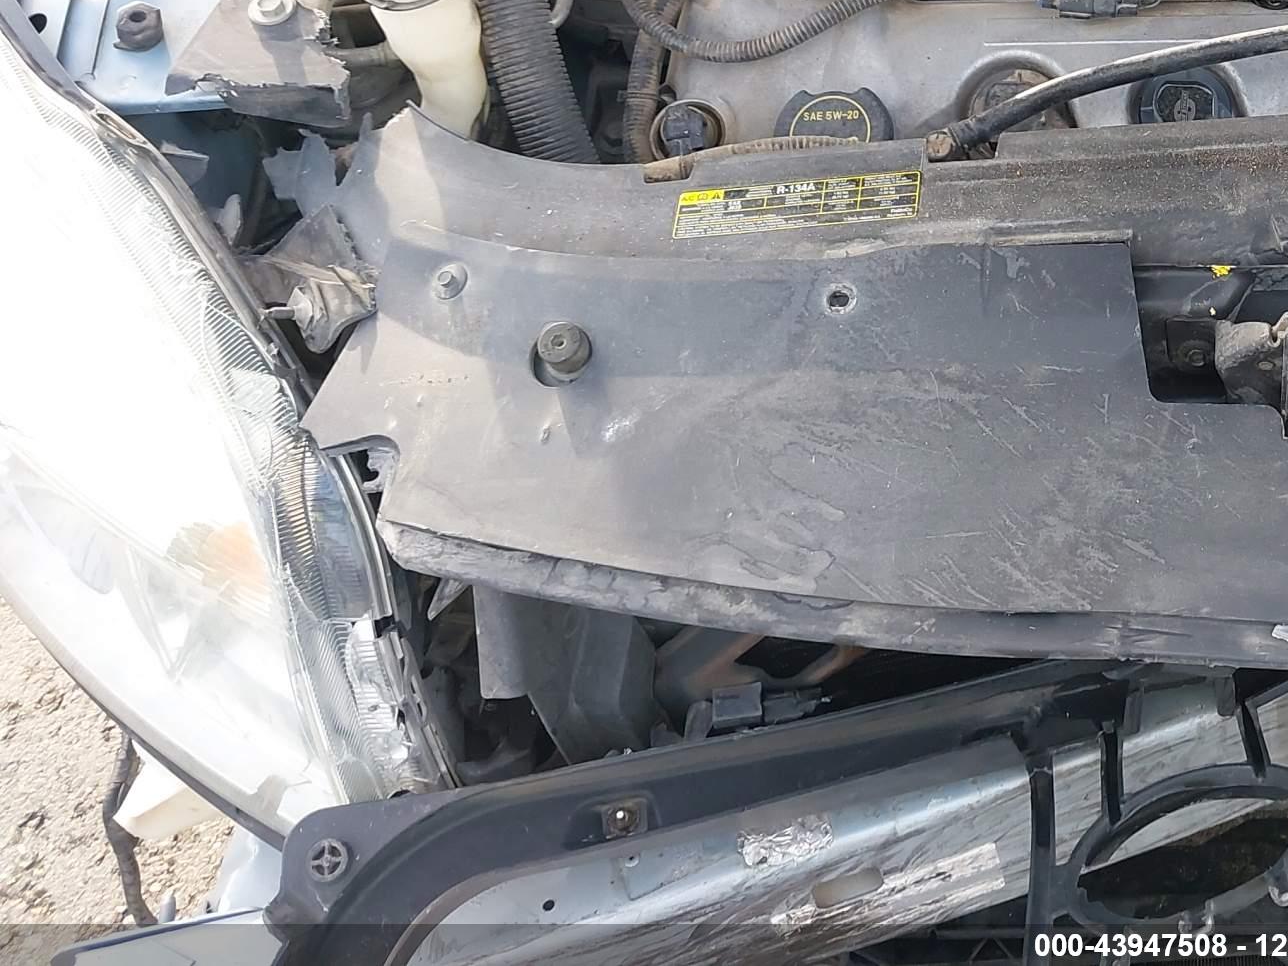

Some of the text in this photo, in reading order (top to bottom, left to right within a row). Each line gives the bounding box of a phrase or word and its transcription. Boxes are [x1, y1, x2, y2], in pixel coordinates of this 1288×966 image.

[803, 110, 860, 121] SAE 5W-20
[776, 183, 816, 194] R-134A
